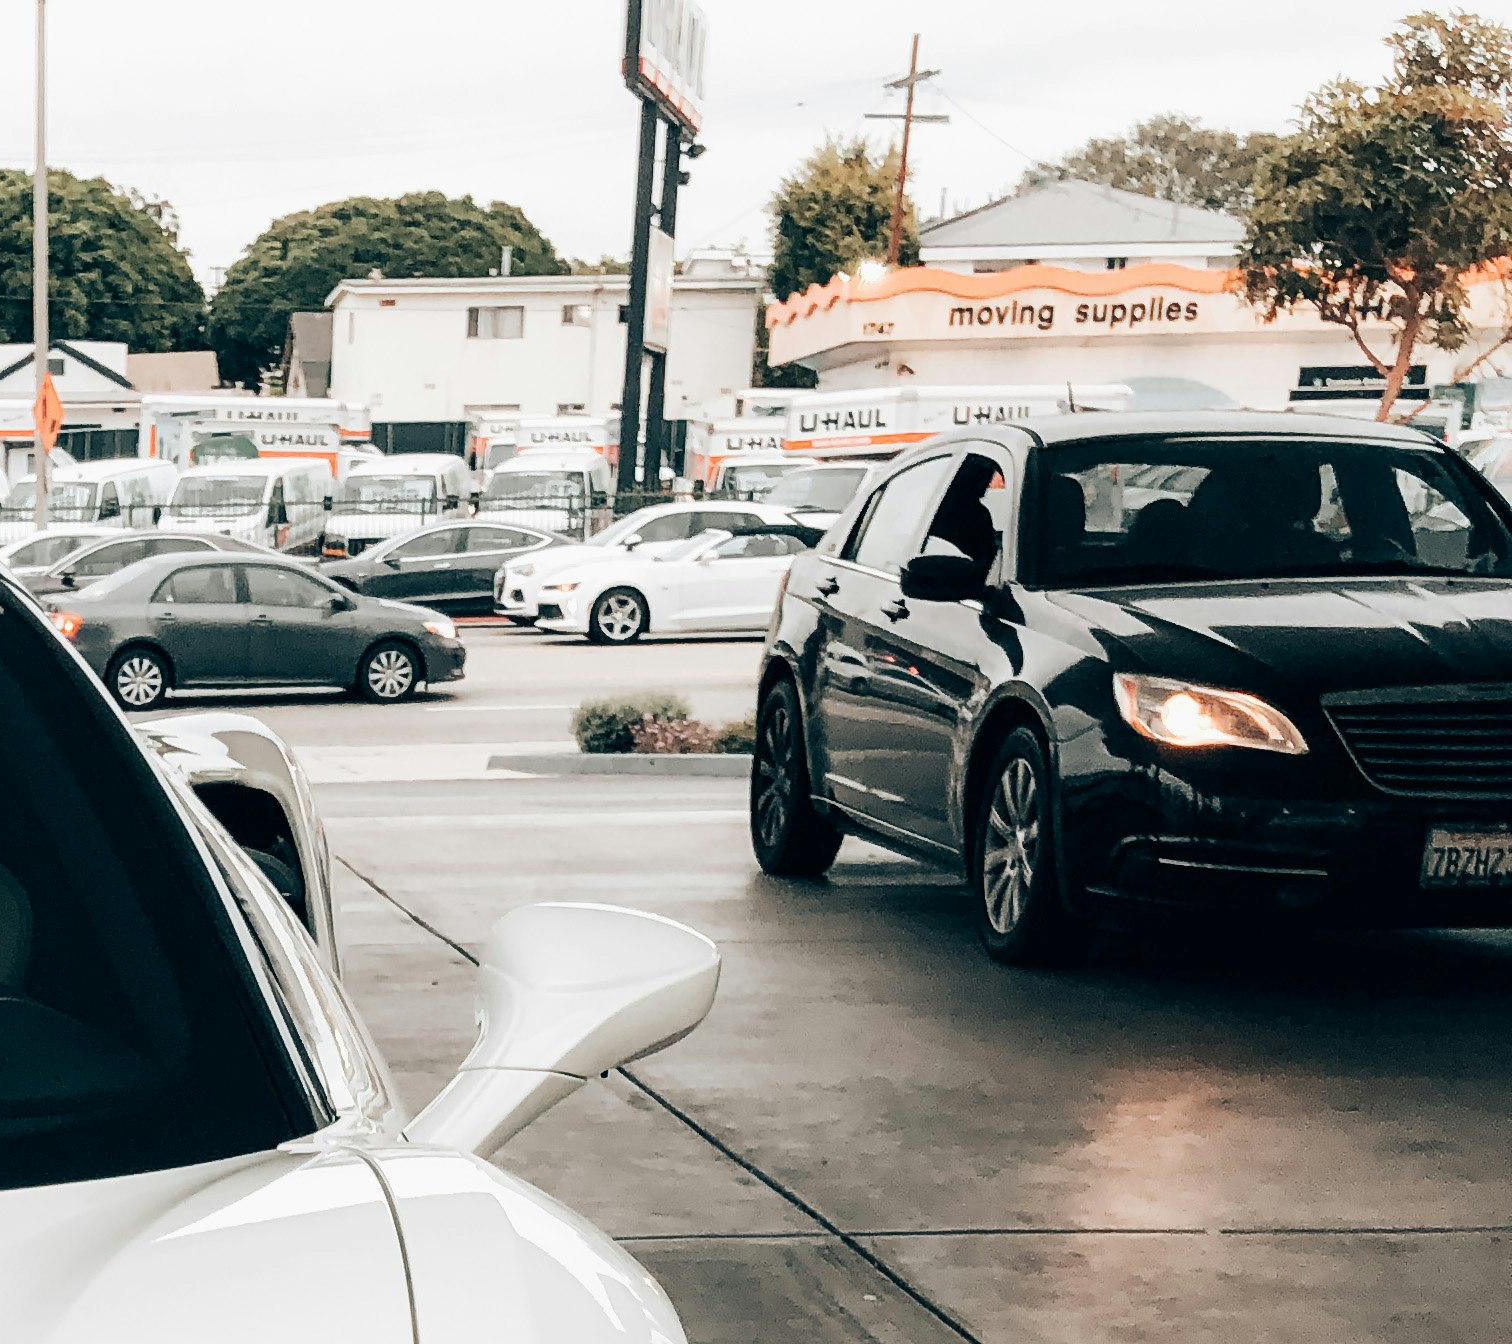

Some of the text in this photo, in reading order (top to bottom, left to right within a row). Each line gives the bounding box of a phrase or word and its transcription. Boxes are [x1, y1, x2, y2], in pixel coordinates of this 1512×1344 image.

[948, 296, 1200, 331] moving supplies
[799, 408, 886, 433] U-HAUL
[260, 433, 329, 446] U-HAUL
[726, 436, 785, 451] U-HA
[1431, 846, 1512, 878] 7BZH2
